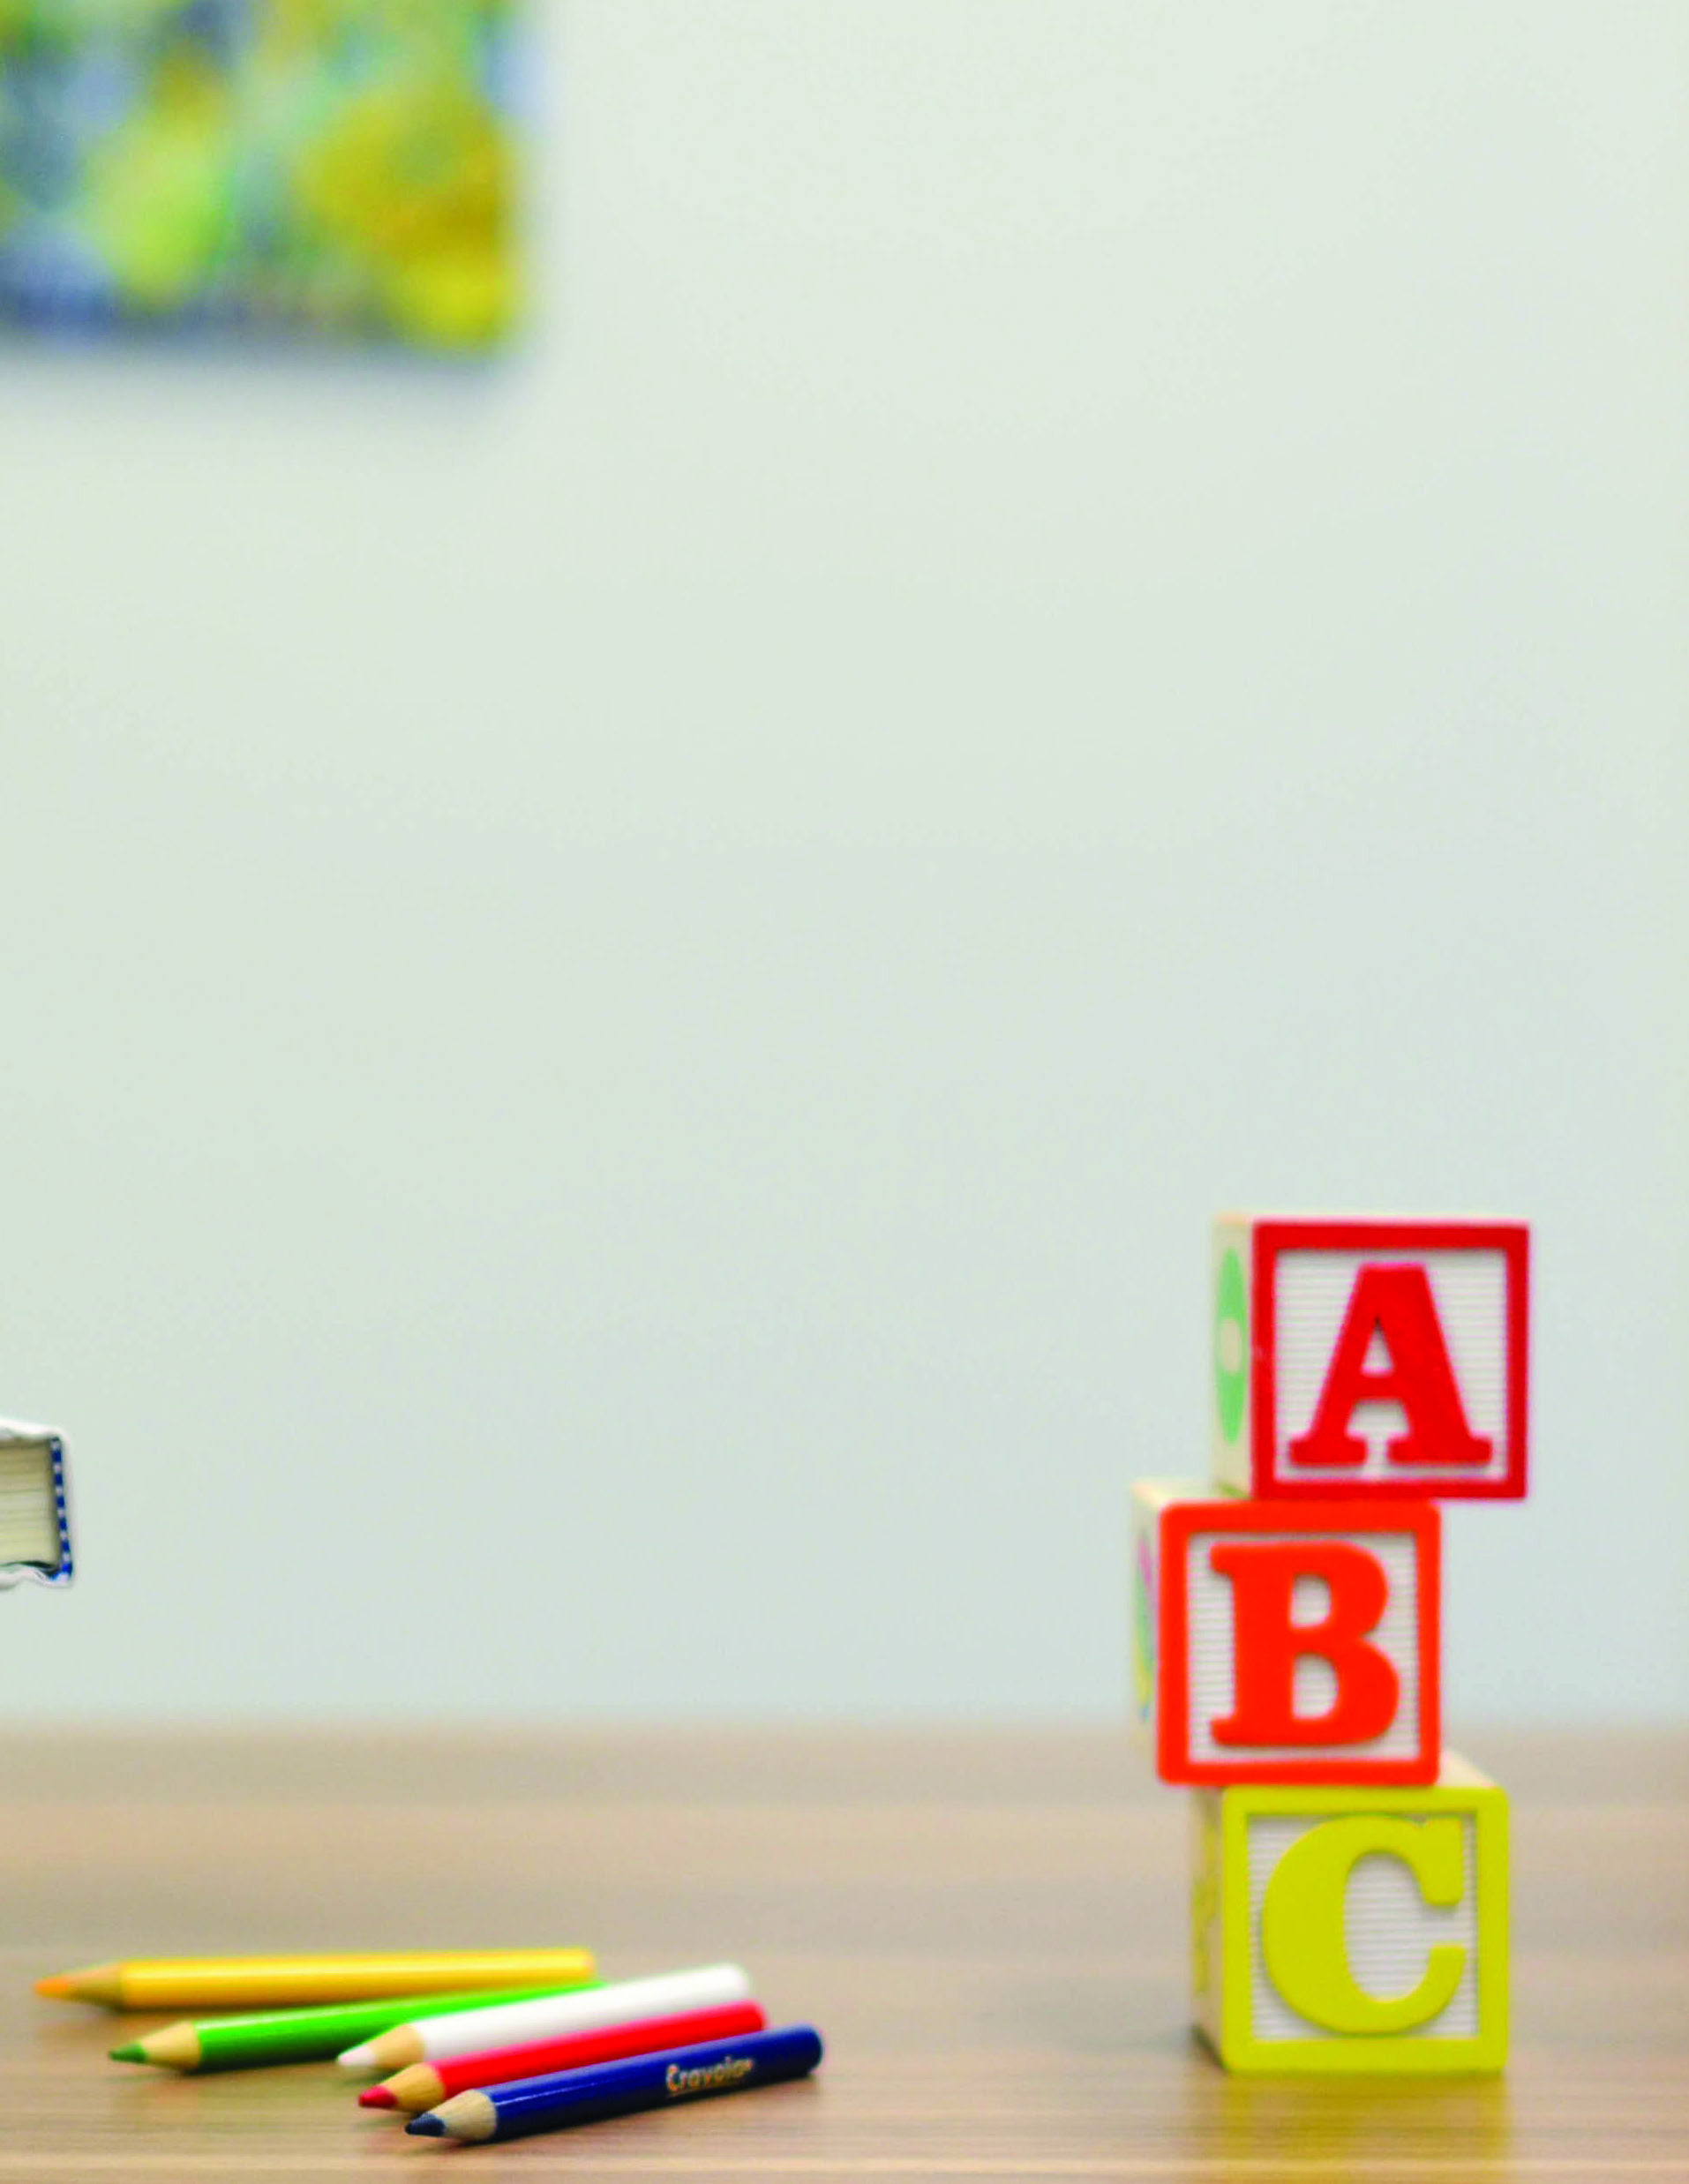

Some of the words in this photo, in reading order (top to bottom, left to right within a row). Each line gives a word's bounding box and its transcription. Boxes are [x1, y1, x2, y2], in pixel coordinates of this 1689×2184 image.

[1289, 1264, 1492, 1466] A
[1210, 1542, 1400, 1747] B
[1261, 1813, 1466, 2034] C
